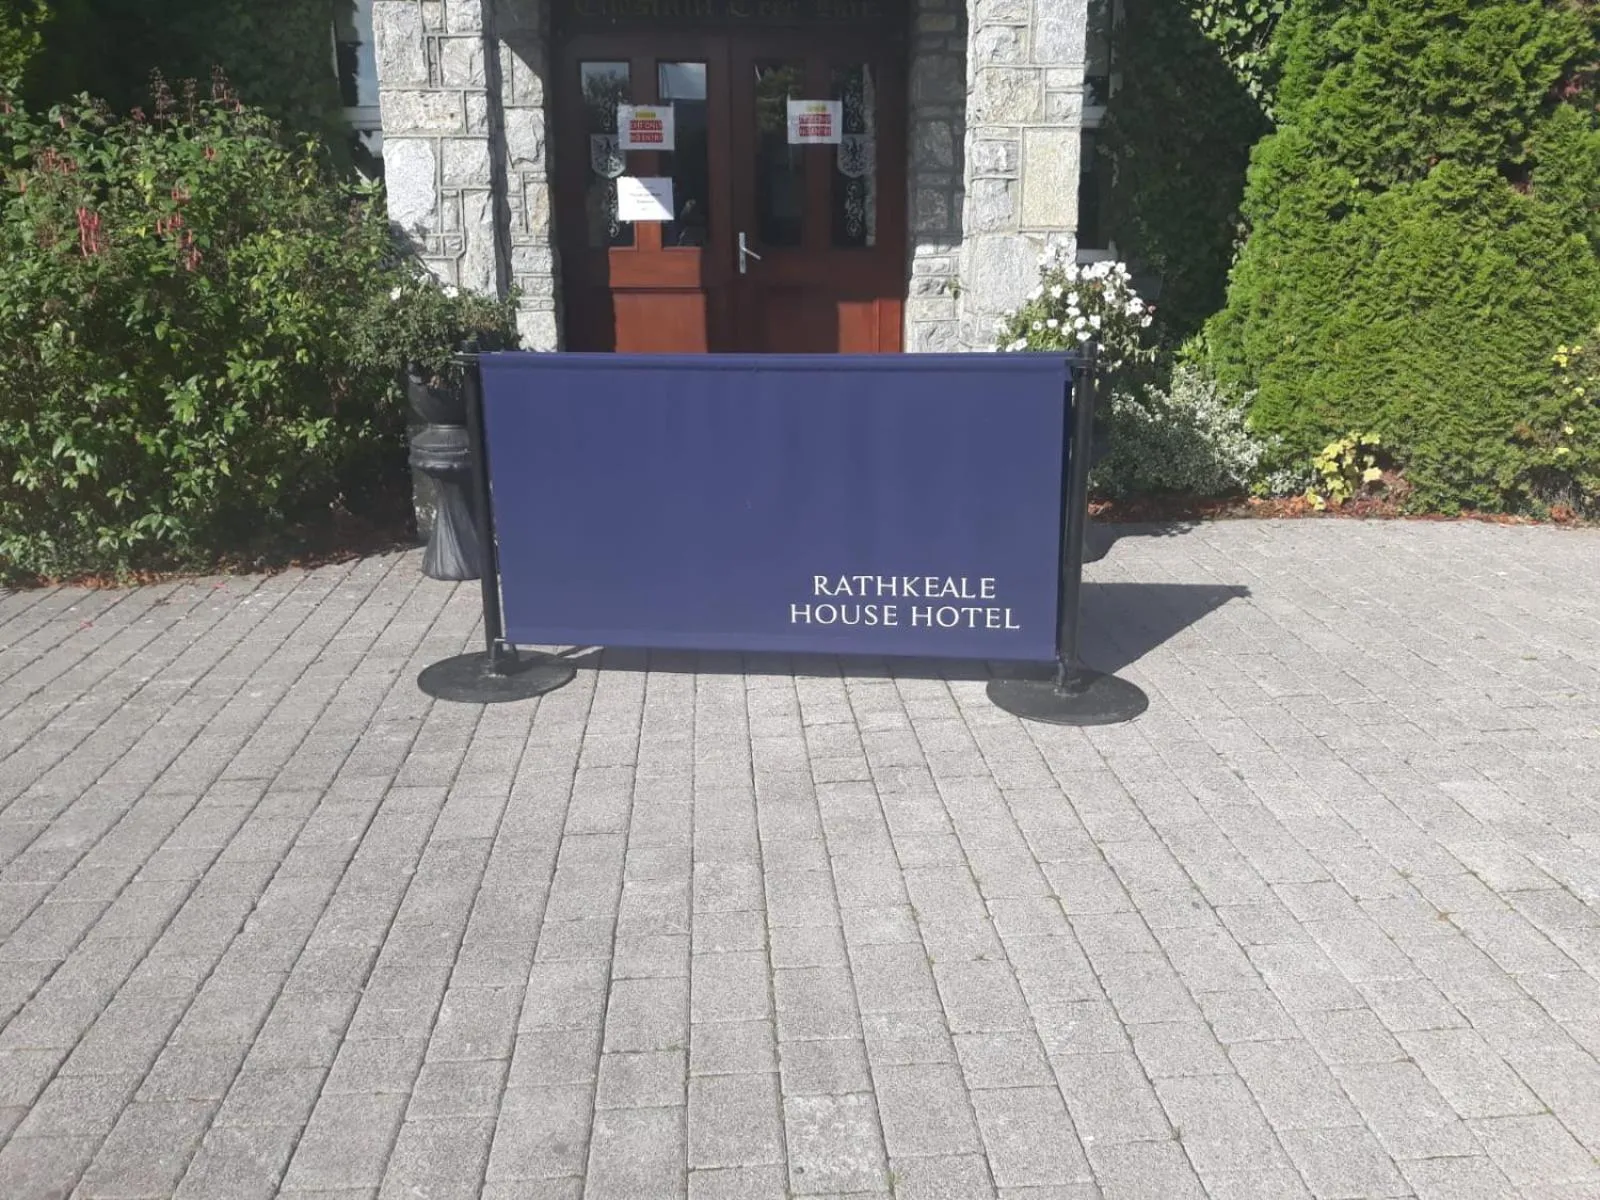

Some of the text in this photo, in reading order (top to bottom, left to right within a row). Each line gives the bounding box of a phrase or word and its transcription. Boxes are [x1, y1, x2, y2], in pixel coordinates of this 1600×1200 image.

[813, 574, 996, 599] RATHKEALE
[790, 603, 1021, 630] HOUSE HOTEL
